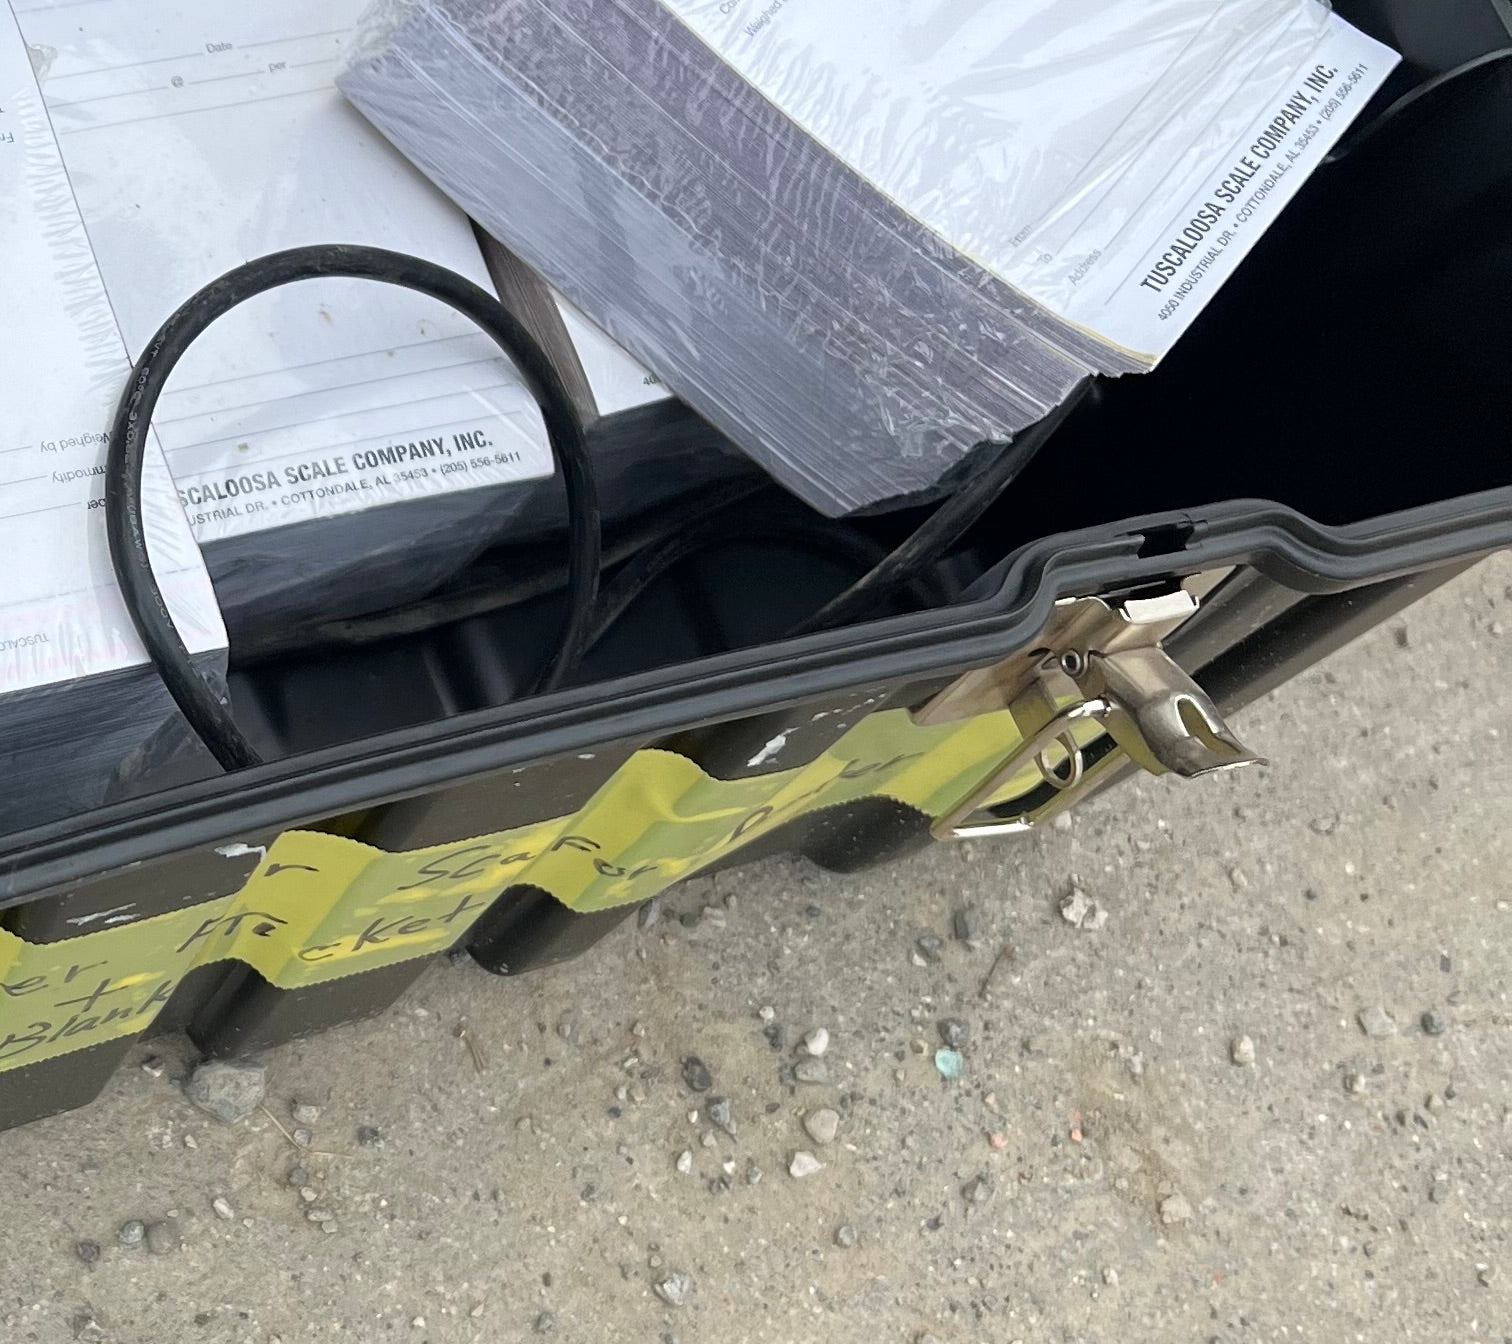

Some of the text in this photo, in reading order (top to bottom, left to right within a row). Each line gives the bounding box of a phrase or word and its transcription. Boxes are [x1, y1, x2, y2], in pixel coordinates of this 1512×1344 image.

[206, 41, 232, 55] Date
[1139, 57, 1339, 297] TUSCALOOSA SCALE COMPANY, INC.
[1066, 247, 1102, 286] Address
[1156, 296, 1180, 322] 4050
[1172, 242, 1223, 301] INDUSTRIAL
[1216, 227, 1236, 248] DR.
[1234, 158, 1291, 225] COTTONDALE,
[1283, 146, 1300, 163] AL
[39, 439, 56, 454] by
[176, 429, 493, 509] SCALOOSA SCALE COMPANY, INC.
[245, 500, 268, 517] DR.
[281, 477, 372, 507] COTTONDALE,
[375, 472, 391, 487] AL
[393, 467, 429, 484] 35453
[440, 460, 469, 478] (205)
[470, 451, 522, 471] 556-5611
